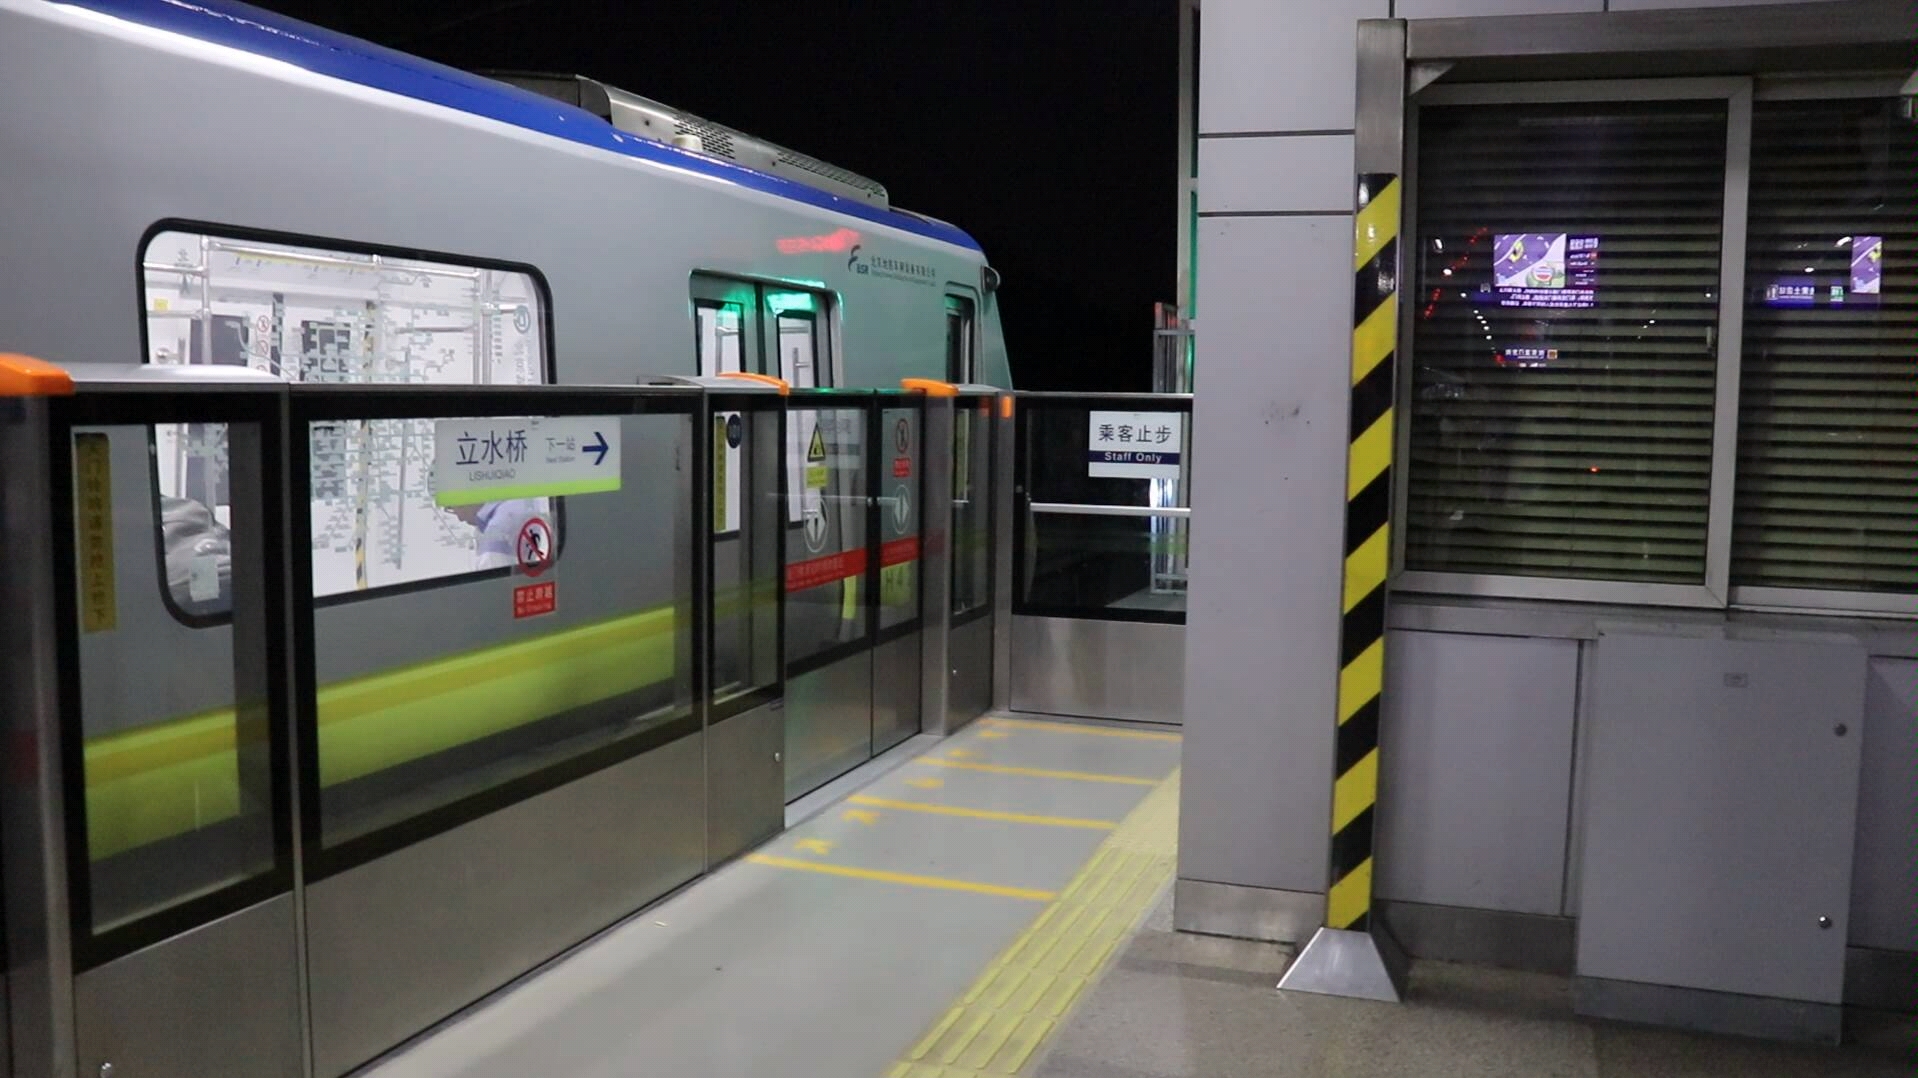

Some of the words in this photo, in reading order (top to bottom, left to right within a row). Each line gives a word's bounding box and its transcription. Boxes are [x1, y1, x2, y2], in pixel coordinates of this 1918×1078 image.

[1098, 424, 1172, 444] 乘客止步
[455, 429, 528, 466] 立水桥
[546, 435, 576, 453] 下一站
[1104, 452, 1132, 462] Staff
[1136, 453, 1162, 464] Only
[469, 468, 516, 482] LISHUIQIAO
